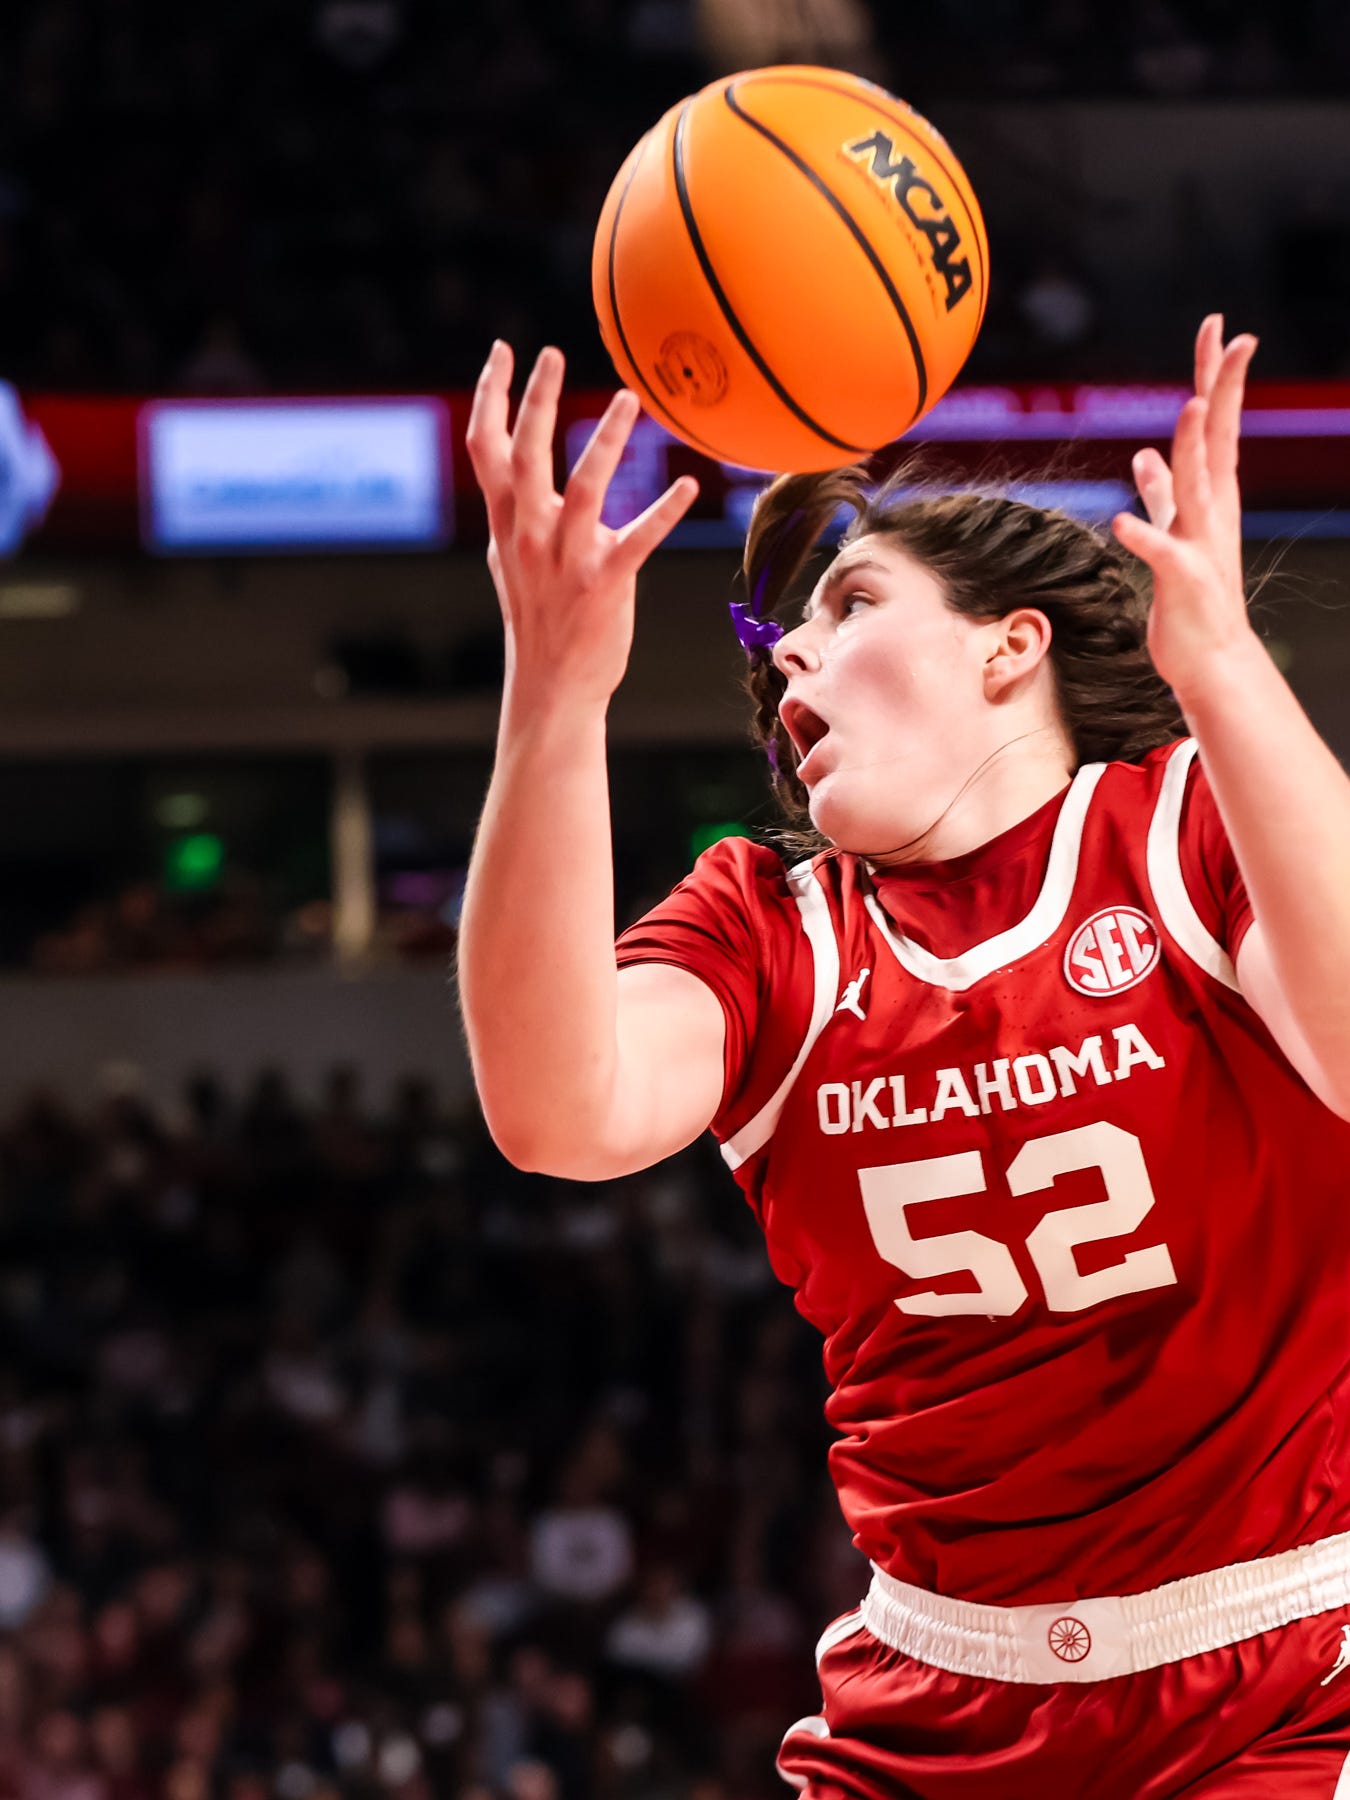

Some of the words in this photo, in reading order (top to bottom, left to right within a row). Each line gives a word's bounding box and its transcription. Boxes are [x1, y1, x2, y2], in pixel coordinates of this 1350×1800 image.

[849, 129, 973, 314] NCAA
[1071, 912, 1155, 989] SEC
[817, 1023, 1166, 1135] OKLAHOMA
[857, 1120, 1178, 1317] 52
